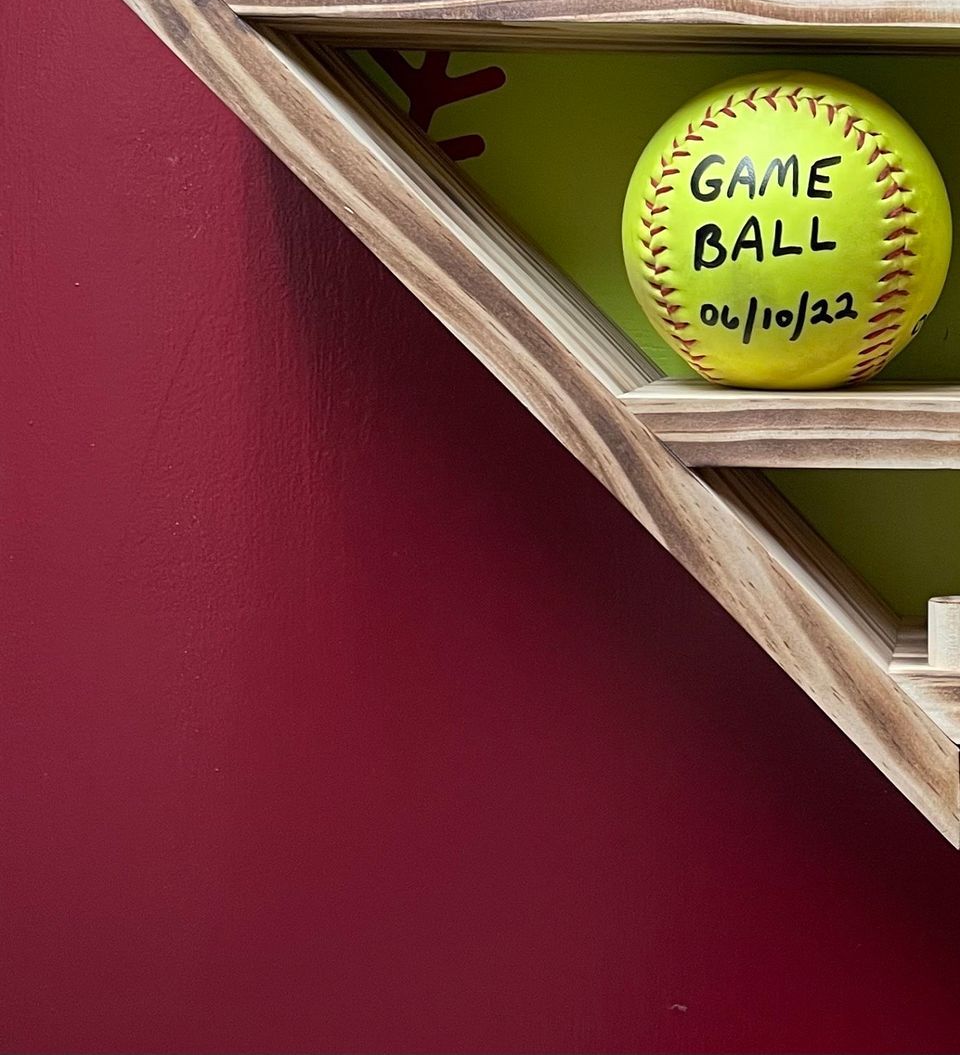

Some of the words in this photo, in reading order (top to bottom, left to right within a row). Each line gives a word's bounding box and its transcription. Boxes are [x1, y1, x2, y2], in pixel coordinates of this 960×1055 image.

[690, 154, 842, 202] GAME
[694, 215, 837, 271] BALL
[700, 290, 858, 344] 06/10/22
